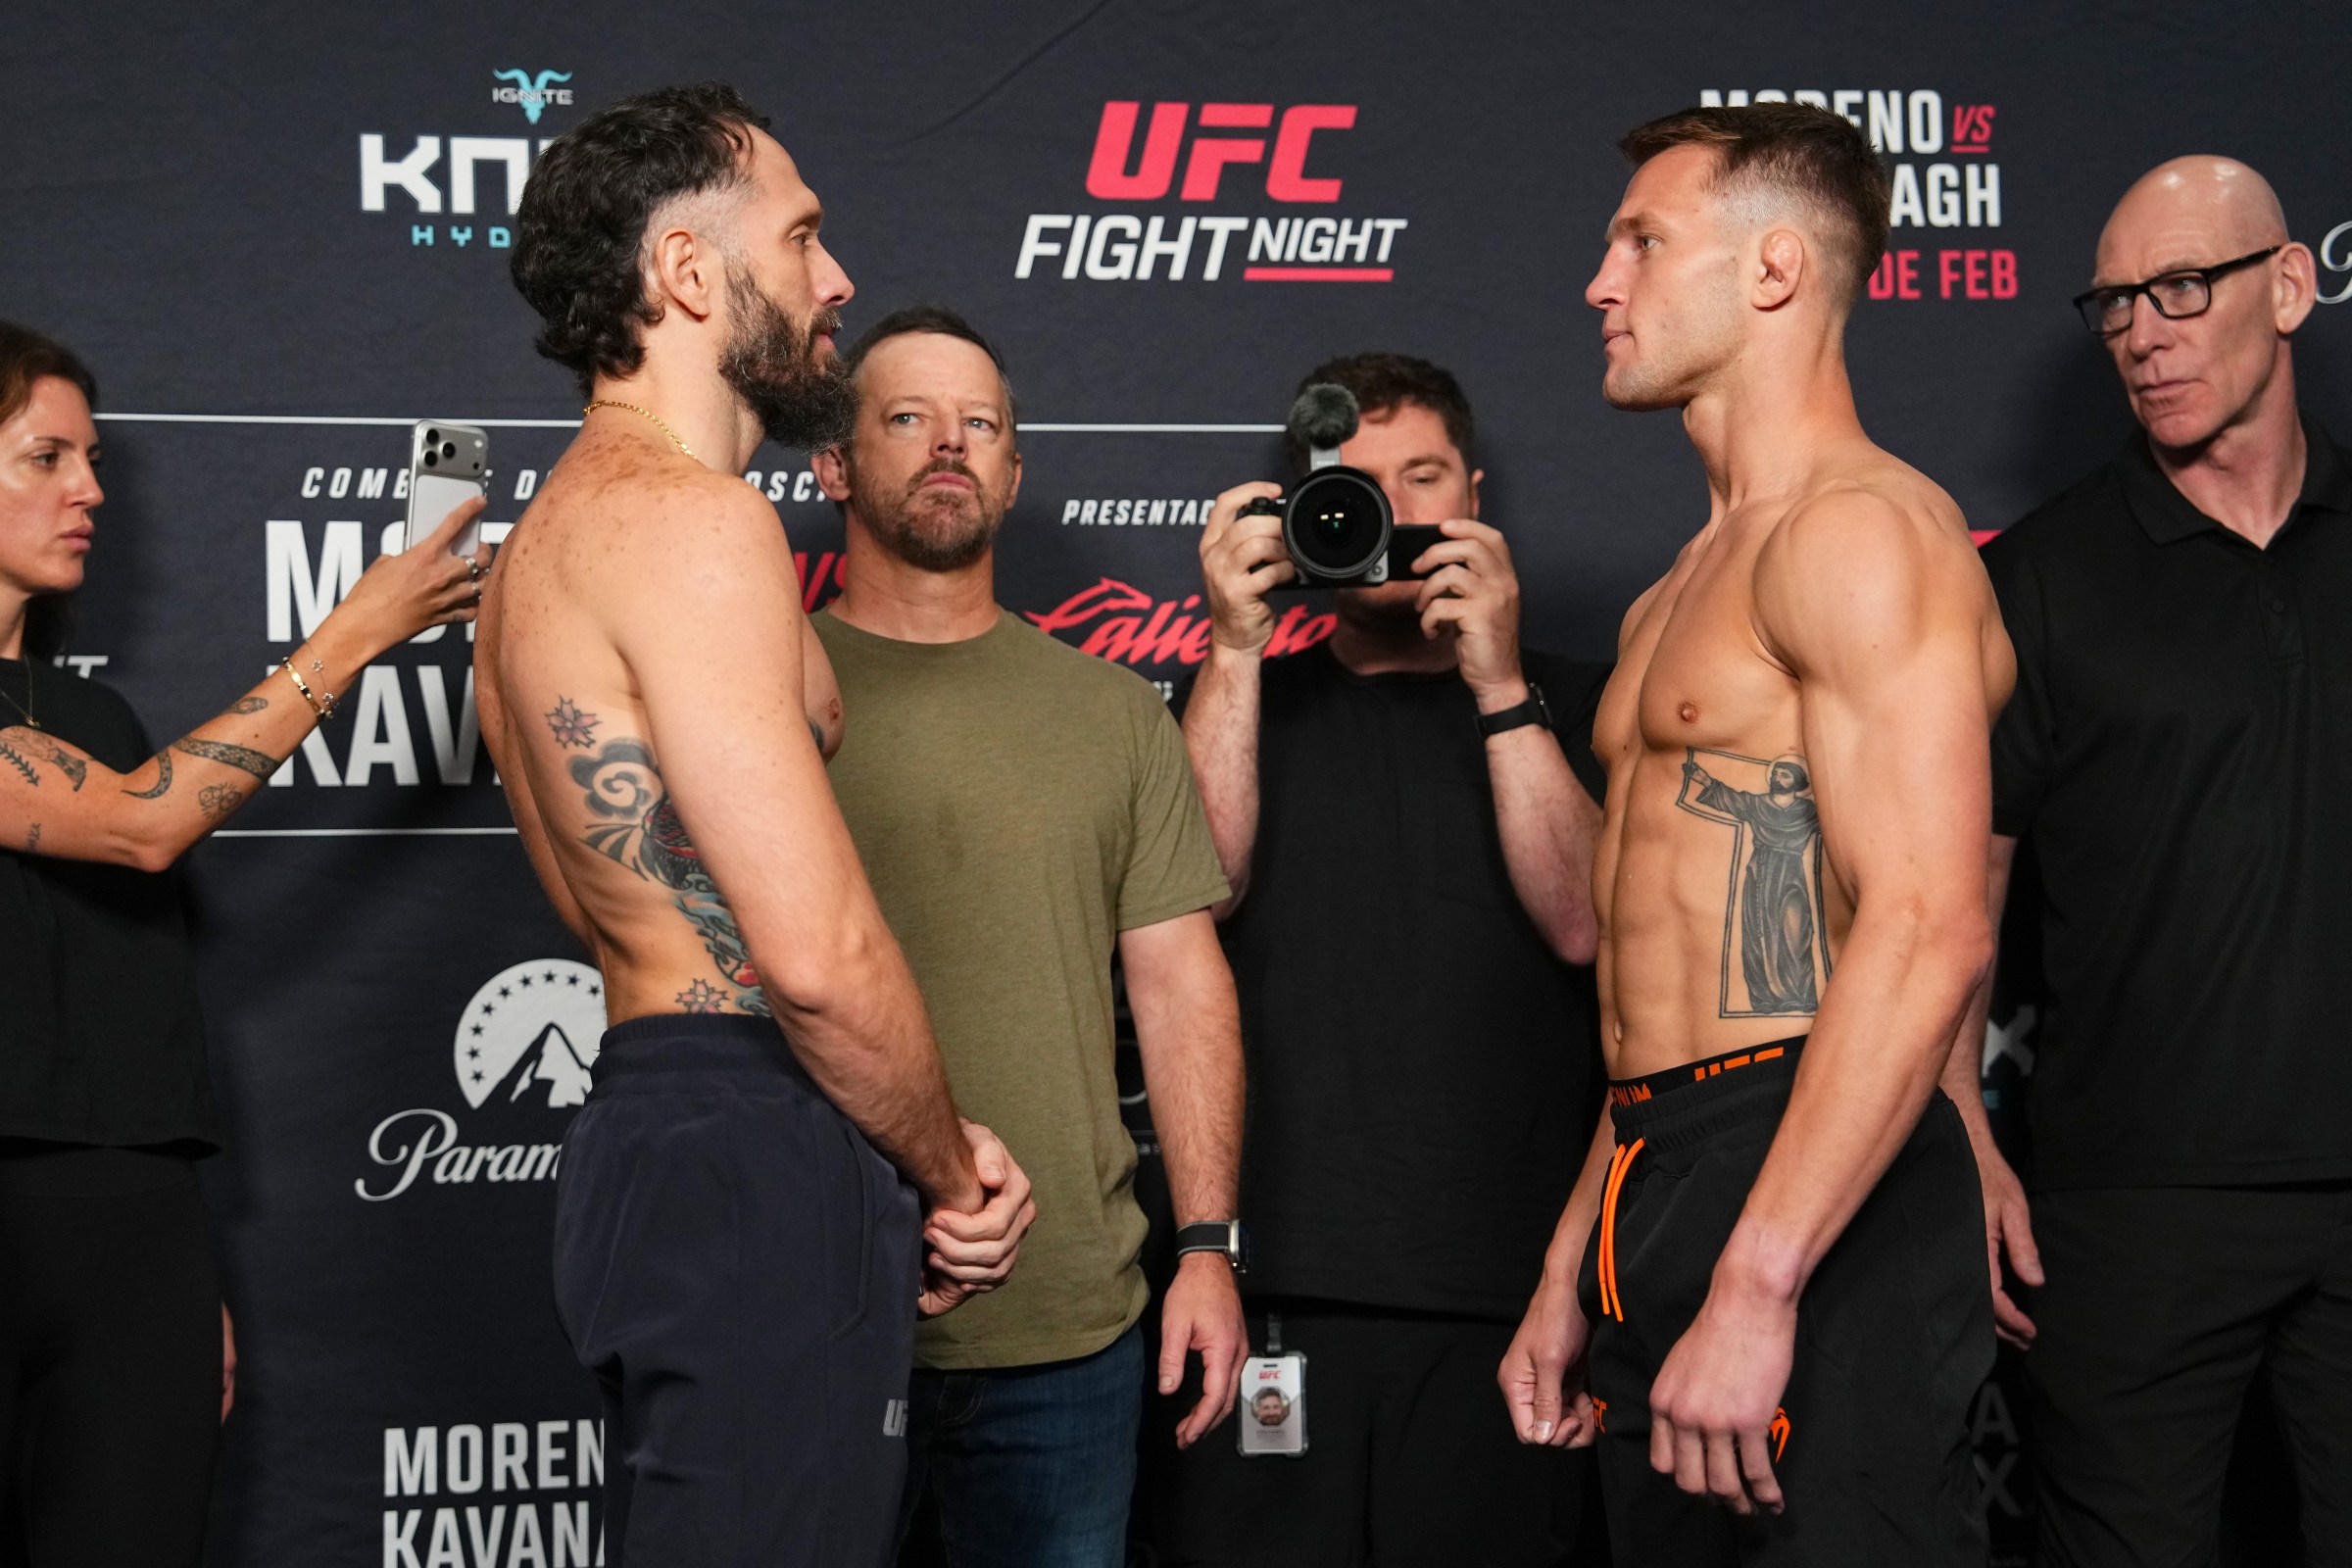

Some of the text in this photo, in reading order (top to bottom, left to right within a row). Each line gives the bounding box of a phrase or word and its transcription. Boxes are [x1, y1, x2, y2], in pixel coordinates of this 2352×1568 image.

[492, 86, 574, 105] IGNITE
[1953, 104, 1996, 143] VS
[1085, 101, 1359, 202] UFC
[1014, 215, 1409, 281] FIGHT NIGHT
[1938, 249, 2019, 300] FEB
[1061, 500, 1216, 526] PRESENTAD
[354, 1107, 563, 1201] Param
[384, 1418, 605, 1497] MOREN
[383, 1500, 606, 1568] KAVAN
